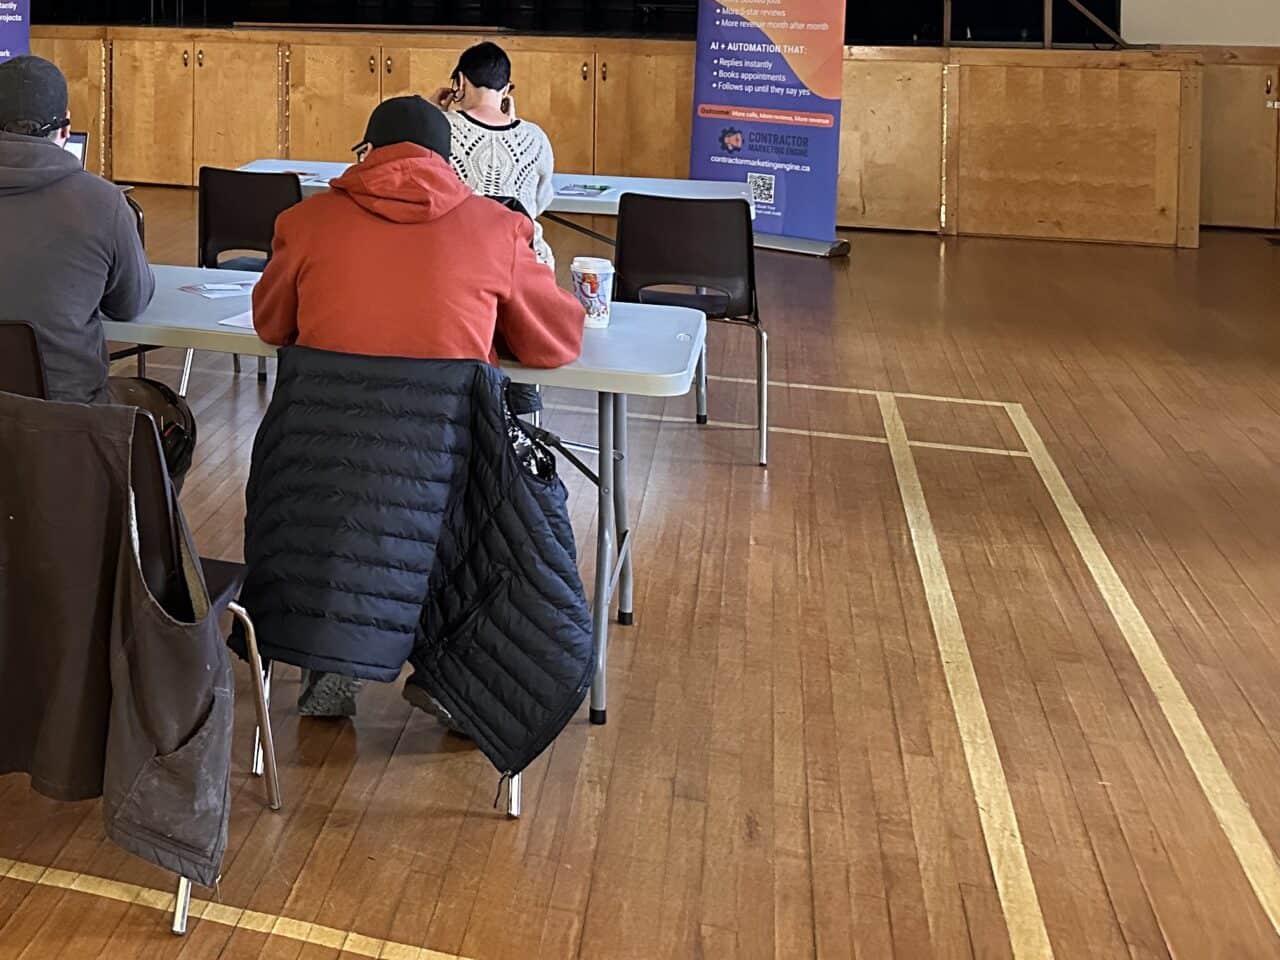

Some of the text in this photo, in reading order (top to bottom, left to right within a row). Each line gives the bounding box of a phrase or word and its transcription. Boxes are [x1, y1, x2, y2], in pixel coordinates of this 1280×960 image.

[720, 19, 739, 28] More
[767, 20, 789, 29] month
[790, 20, 805, 29] after
[807, 21, 829, 31] month
[710, 42, 719, 50] AI
[727, 42, 781, 53] AUTOMATION
[783, 45, 808, 54] THAT:
[719, 58, 773, 70] Replies instantly
[718, 70, 786, 82] Books appointments
[718, 81, 811, 97] Follows up until they say yes
[749, 131, 809, 147] CONTRACTOR
[748, 144, 785, 156] MARKETING
[710, 155, 811, 172] contractormarketingengine.ca
